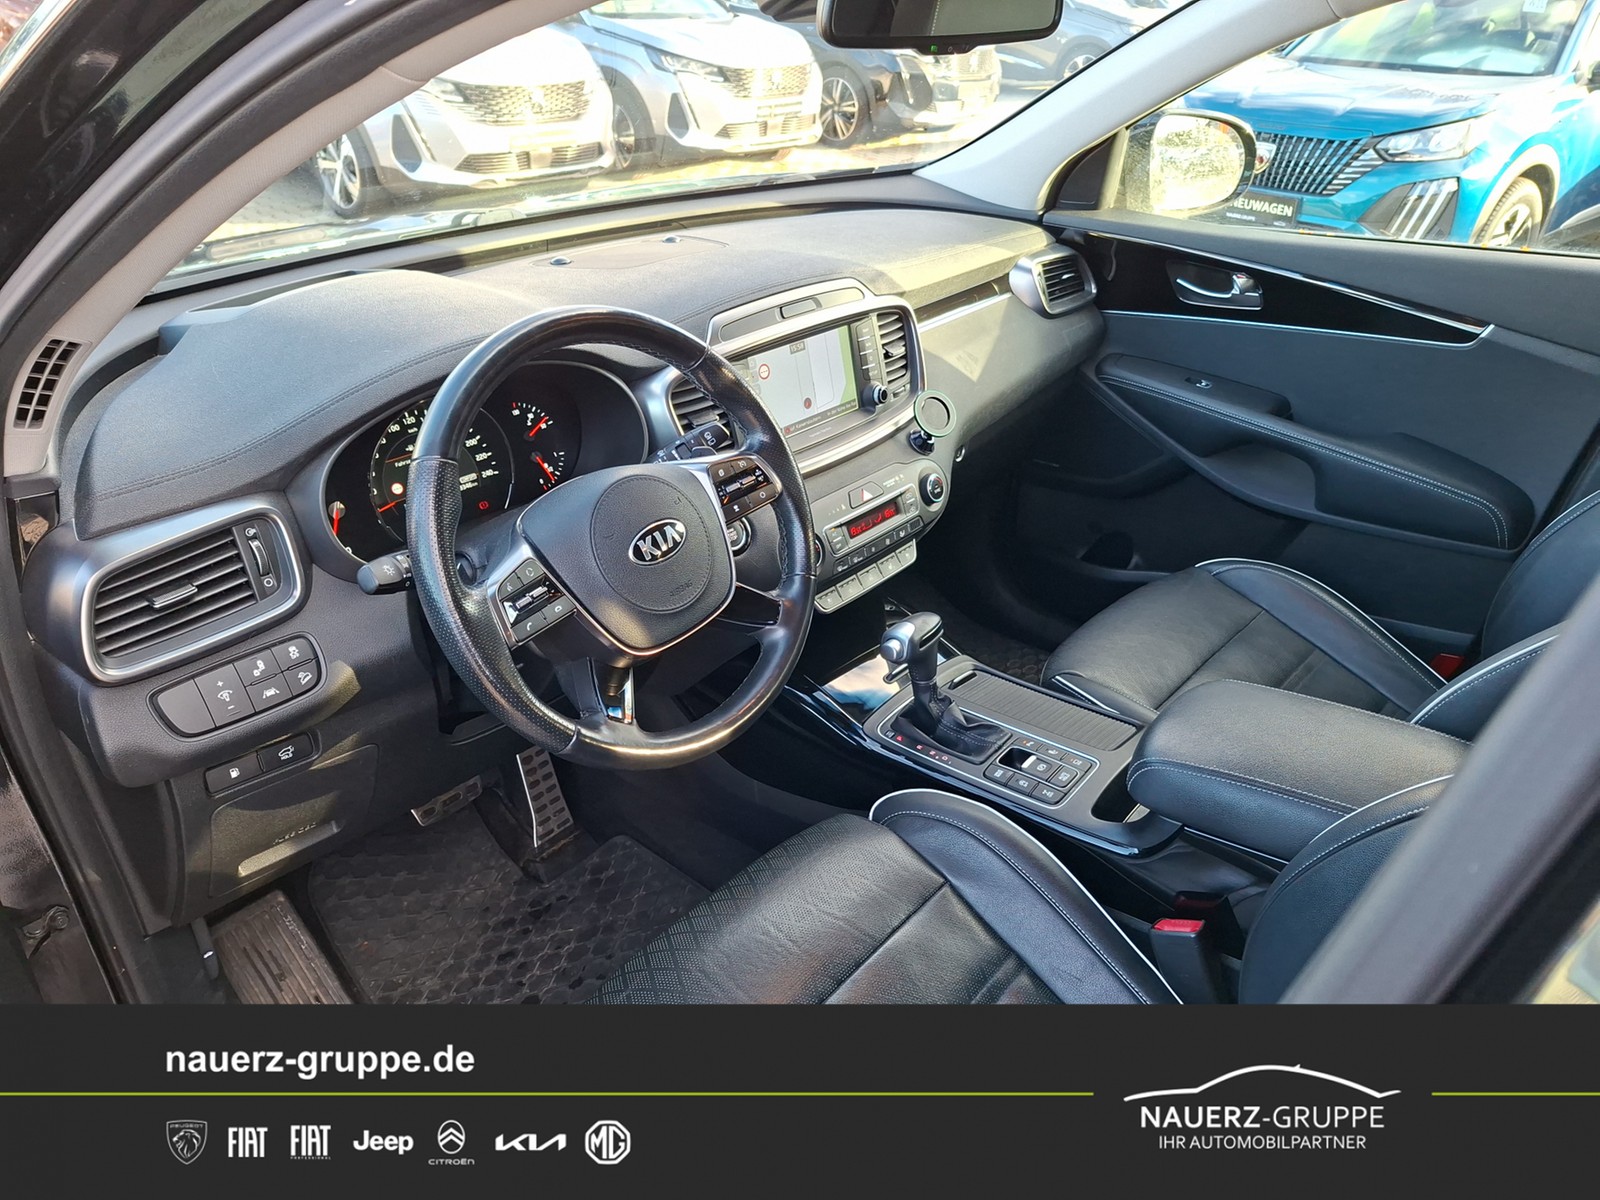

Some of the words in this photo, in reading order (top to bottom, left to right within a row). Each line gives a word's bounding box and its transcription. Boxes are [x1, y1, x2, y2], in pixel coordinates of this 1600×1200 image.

[403, 416, 416, 425] 120
[465, 438, 478, 447] 200
[475, 452, 487, 461] 220
[636, 525, 682, 561] KIA
